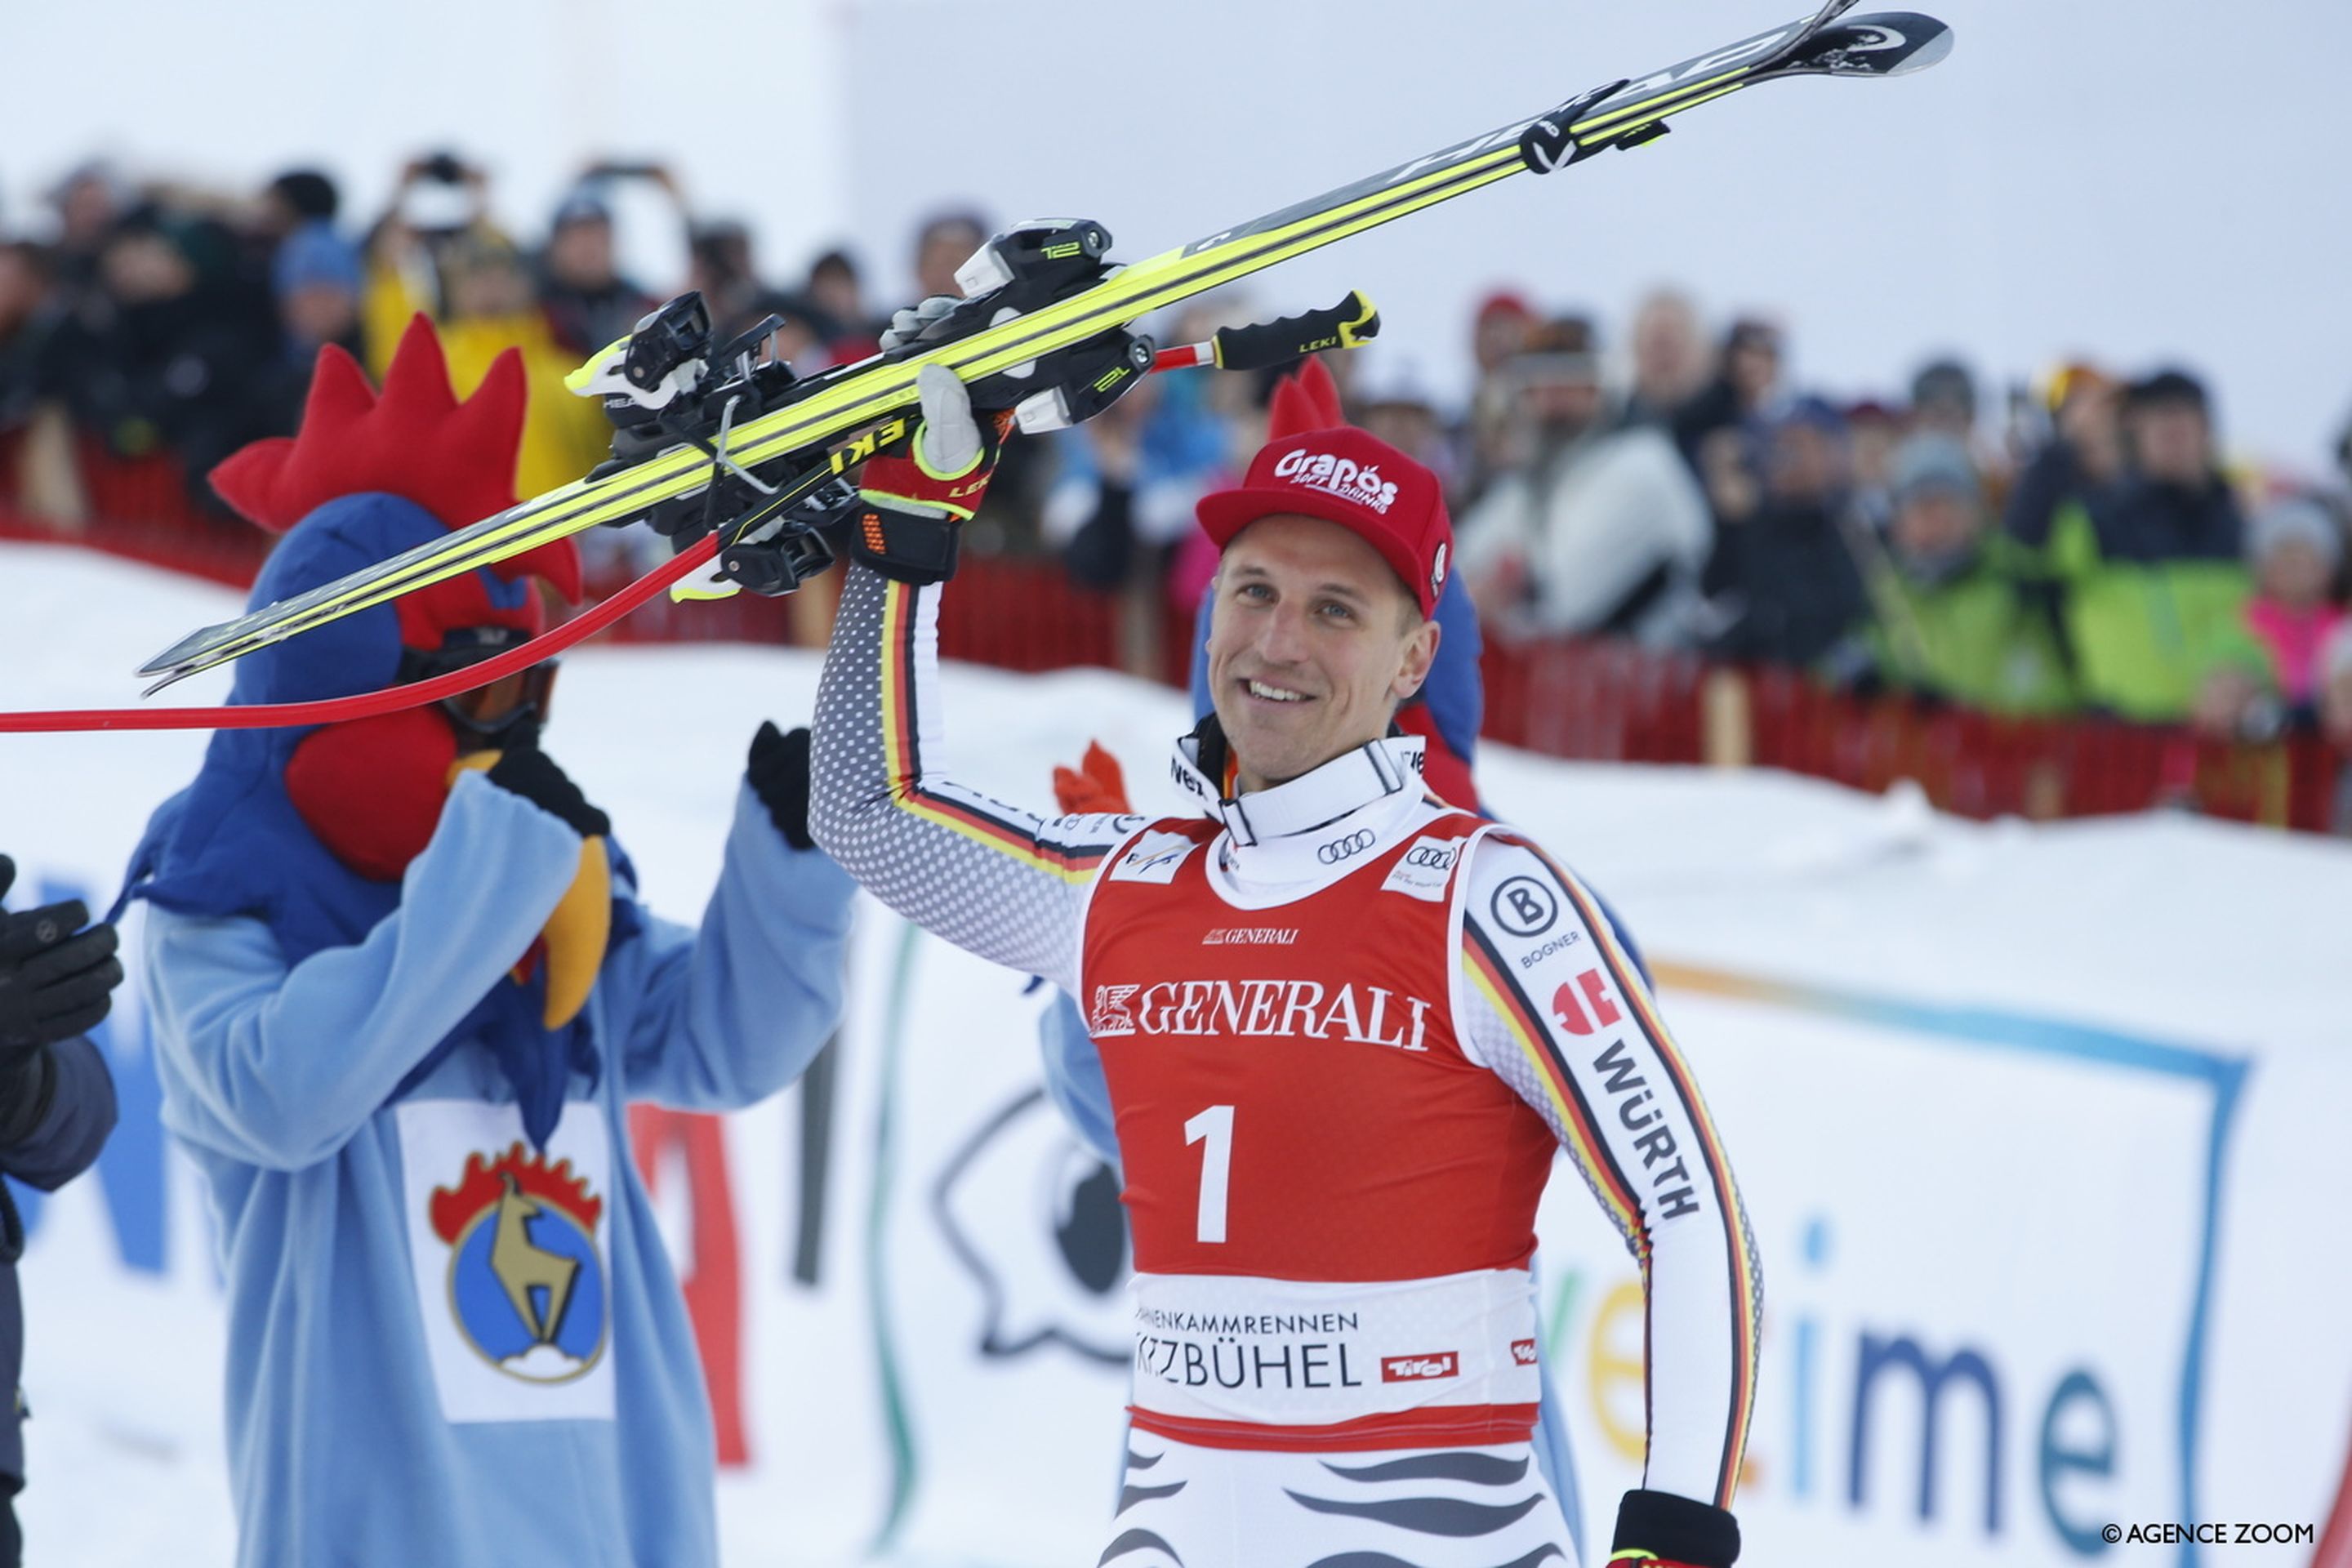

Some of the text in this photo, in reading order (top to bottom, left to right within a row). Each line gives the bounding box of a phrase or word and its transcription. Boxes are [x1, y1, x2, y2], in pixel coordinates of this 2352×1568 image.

[1299, 336, 1336, 353] LEKI
[830, 417, 905, 475] EKI
[1507, 888, 1544, 925] B
[1225, 928, 1299, 945] GENERALI
[1521, 931, 1581, 969] BOGNER
[1138, 980, 1432, 1052] GENERALI
[1592, 1039, 1700, 1221] WÜRTH
[1184, 1105, 1236, 1243] 1
[1388, 1355, 1452, 1377] Tirol
